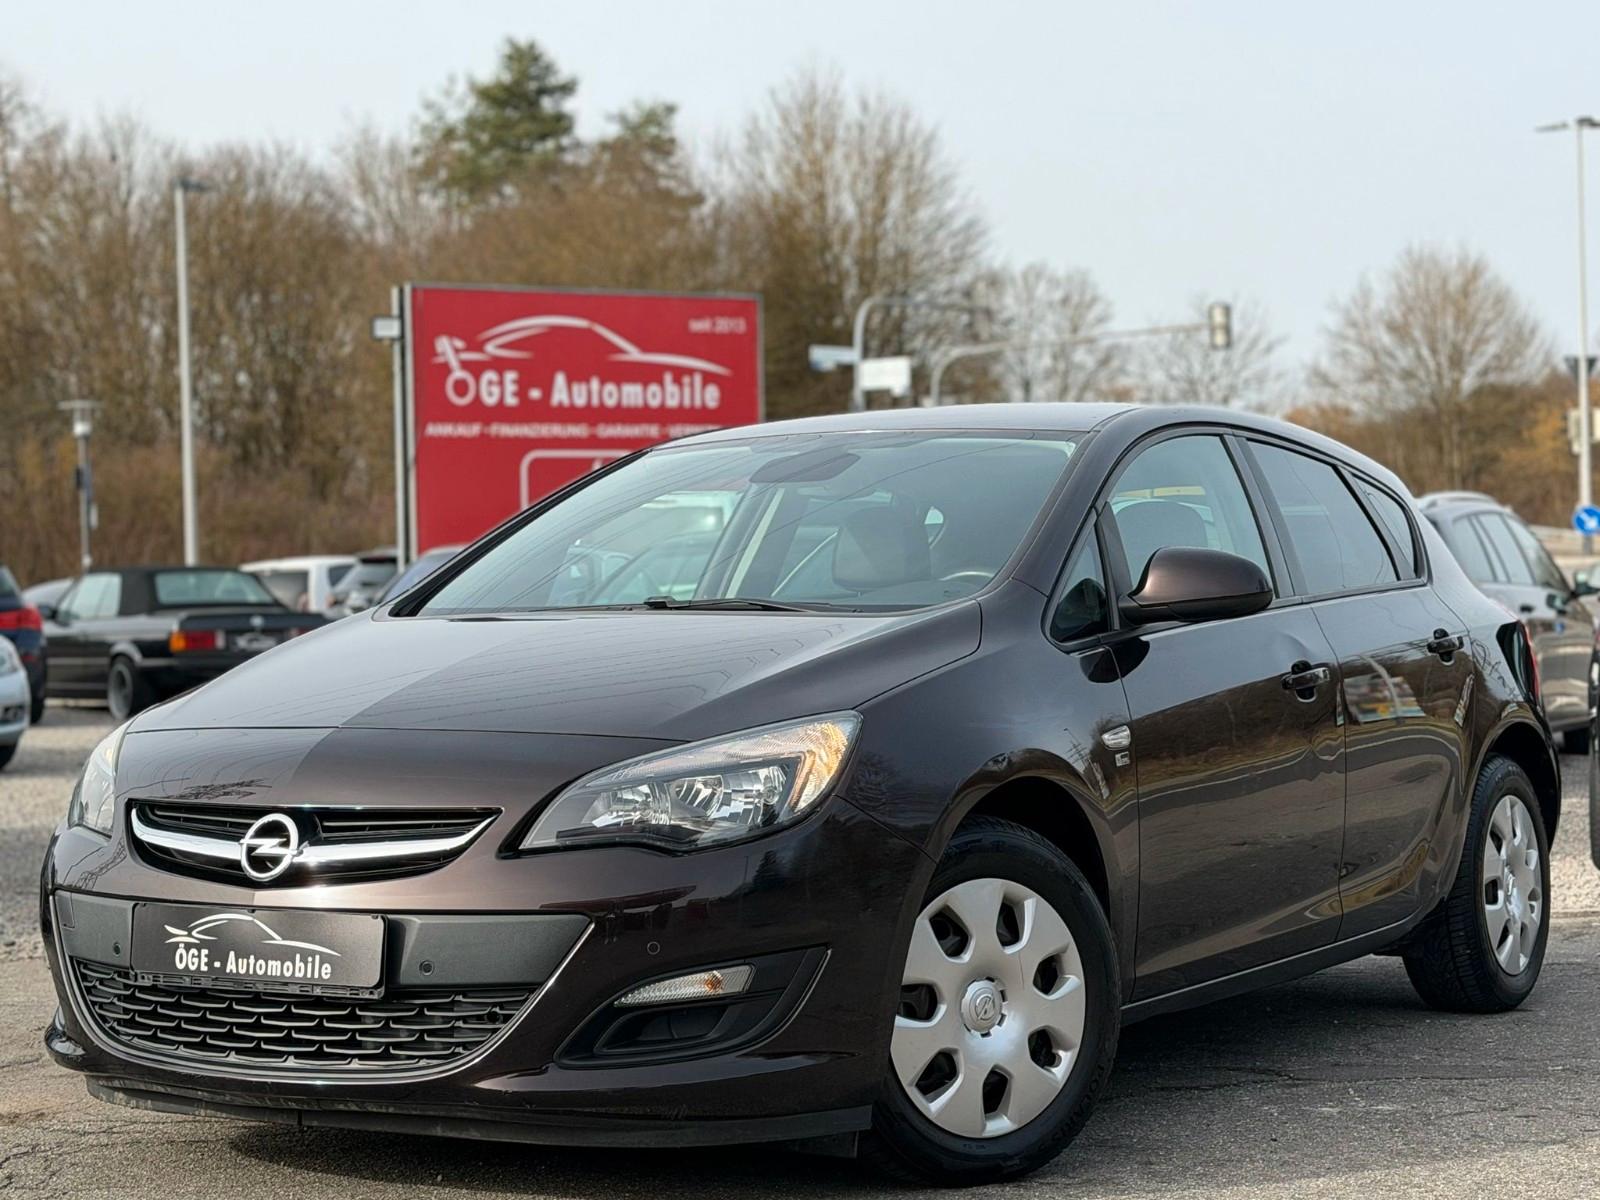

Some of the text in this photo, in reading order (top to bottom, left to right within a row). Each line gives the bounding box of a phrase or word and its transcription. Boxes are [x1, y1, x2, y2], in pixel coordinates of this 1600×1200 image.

[551, 371, 721, 409] Automobile
[175, 943, 209, 972] ÖGE
[226, 951, 332, 979] Automobile
